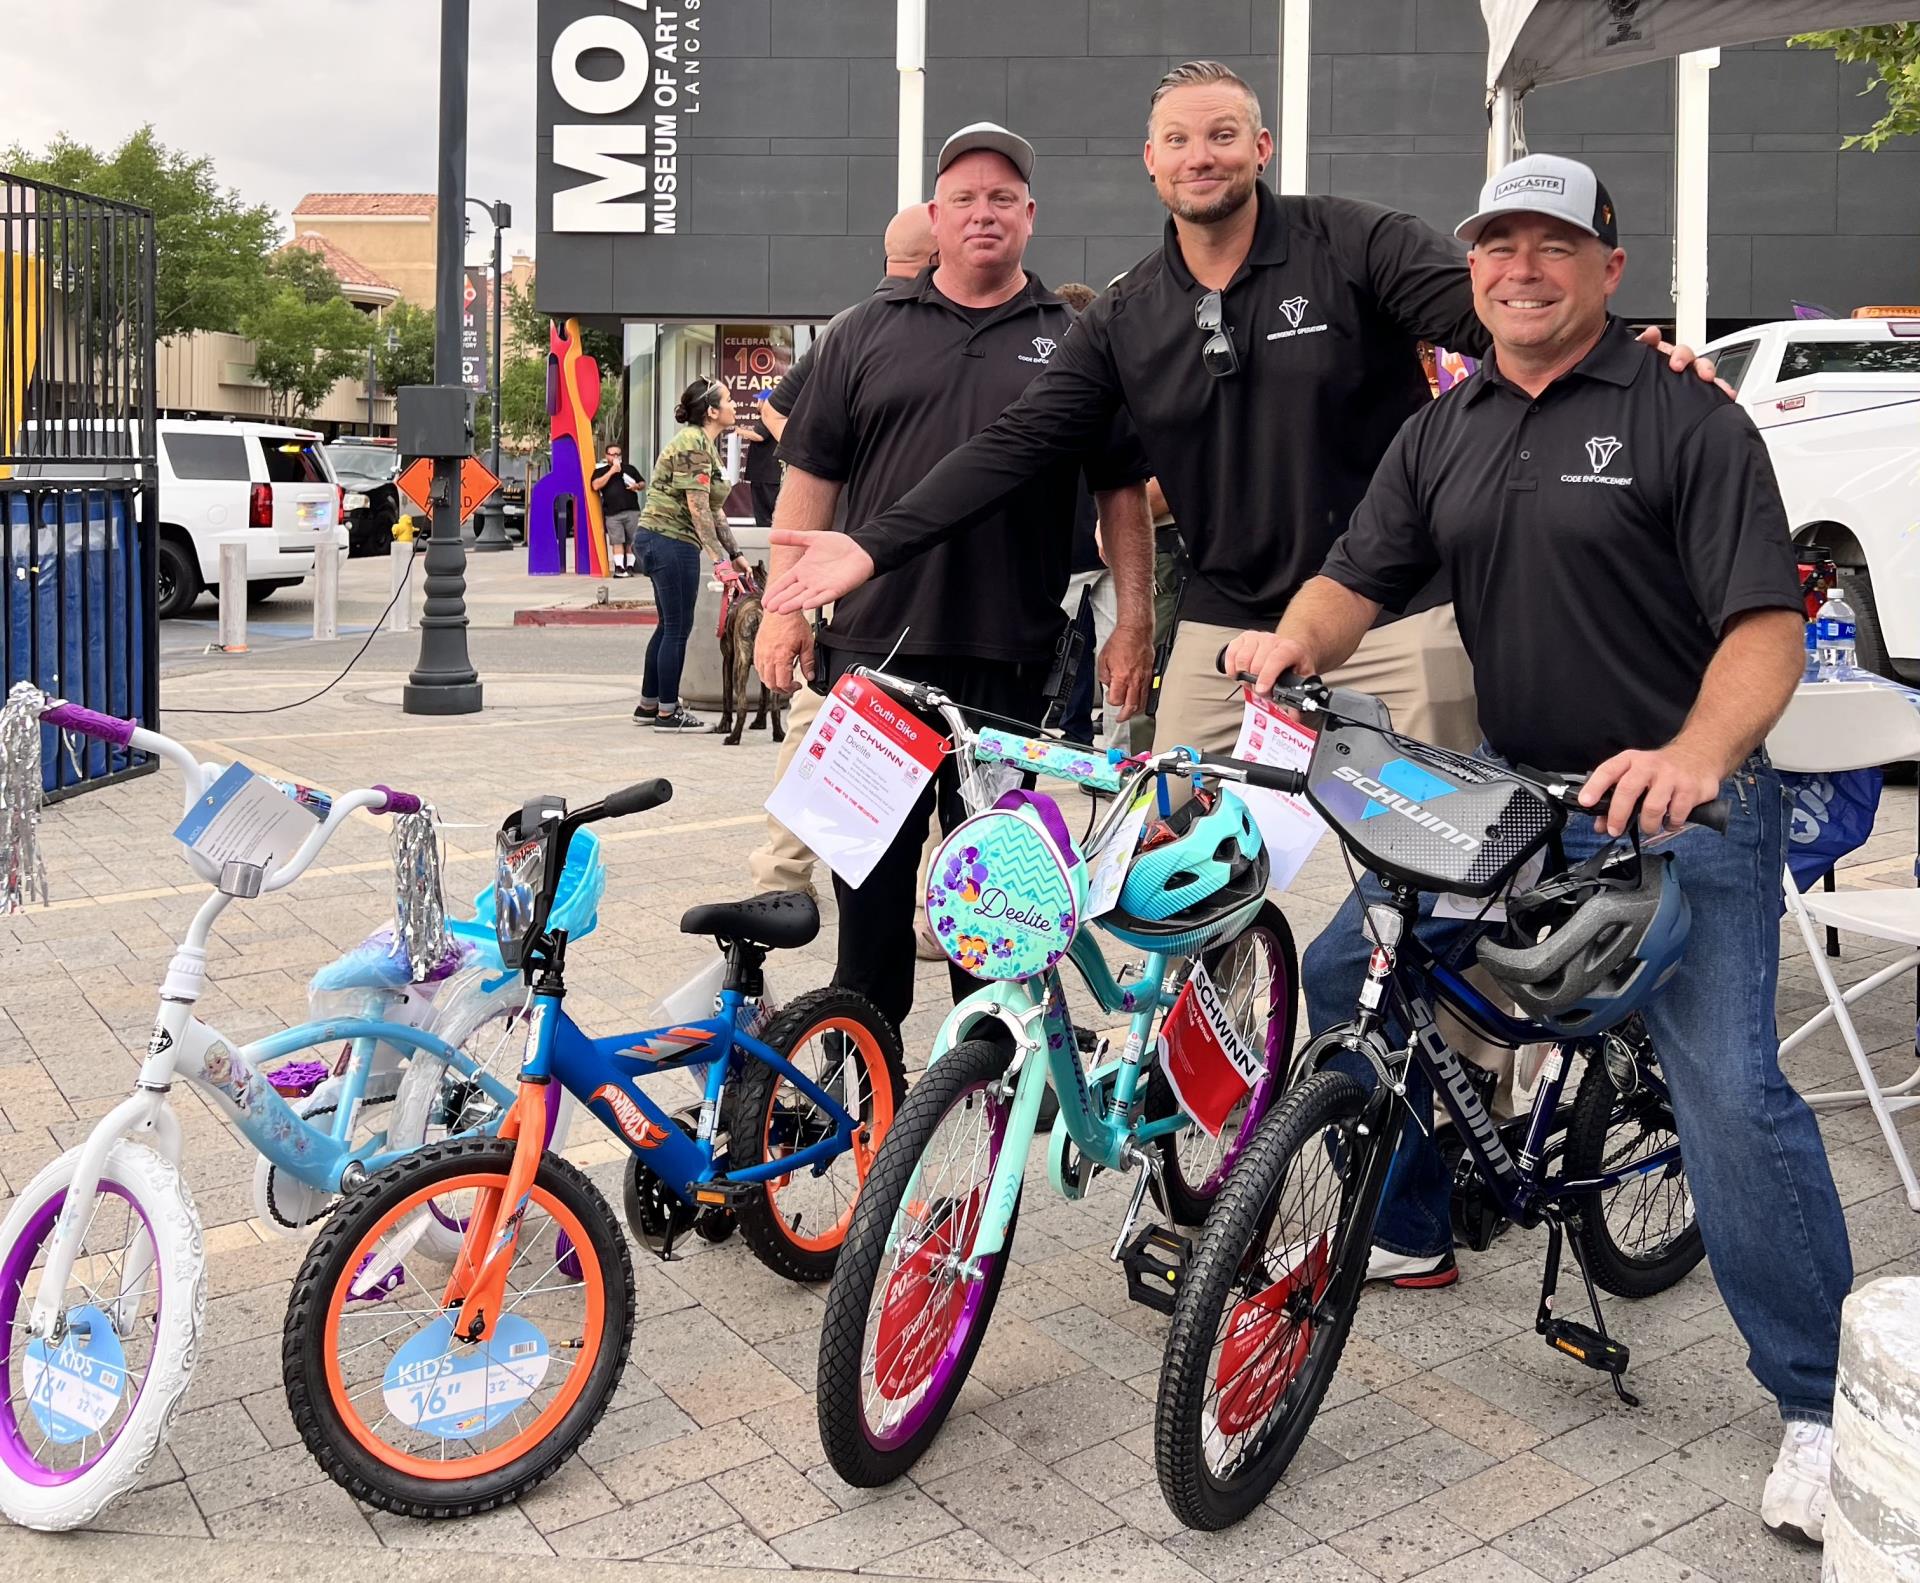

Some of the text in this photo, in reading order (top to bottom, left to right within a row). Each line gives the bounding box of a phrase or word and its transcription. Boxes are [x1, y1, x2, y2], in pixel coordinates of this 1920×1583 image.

[684, 0, 701, 114] LANCAS
[551, 0, 649, 233] MO
[653, 4, 679, 235] MUSEUM OF ART
[1498, 179, 1560, 195] LANCASTER
[724, 375, 783, 390] YEARS
[735, 347, 776, 374] 10
[1560, 475, 1633, 486] CODE ENFORCEMENT
[867, 696, 896, 724] Youth
[895, 718, 918, 742] Bike
[845, 734, 872, 761] Deelite
[852, 723, 905, 768] SCHWINN
[1332, 766, 1480, 851] SCHWINN
[973, 887, 1052, 932] Deelite
[1195, 970, 1257, 1078] SCHWINN
[1410, 997, 1515, 1175] SCHWINN
[59, 1347, 93, 1377] KIDS
[398, 1355, 455, 1386] KIDS
[410, 1382, 462, 1418] 16"
